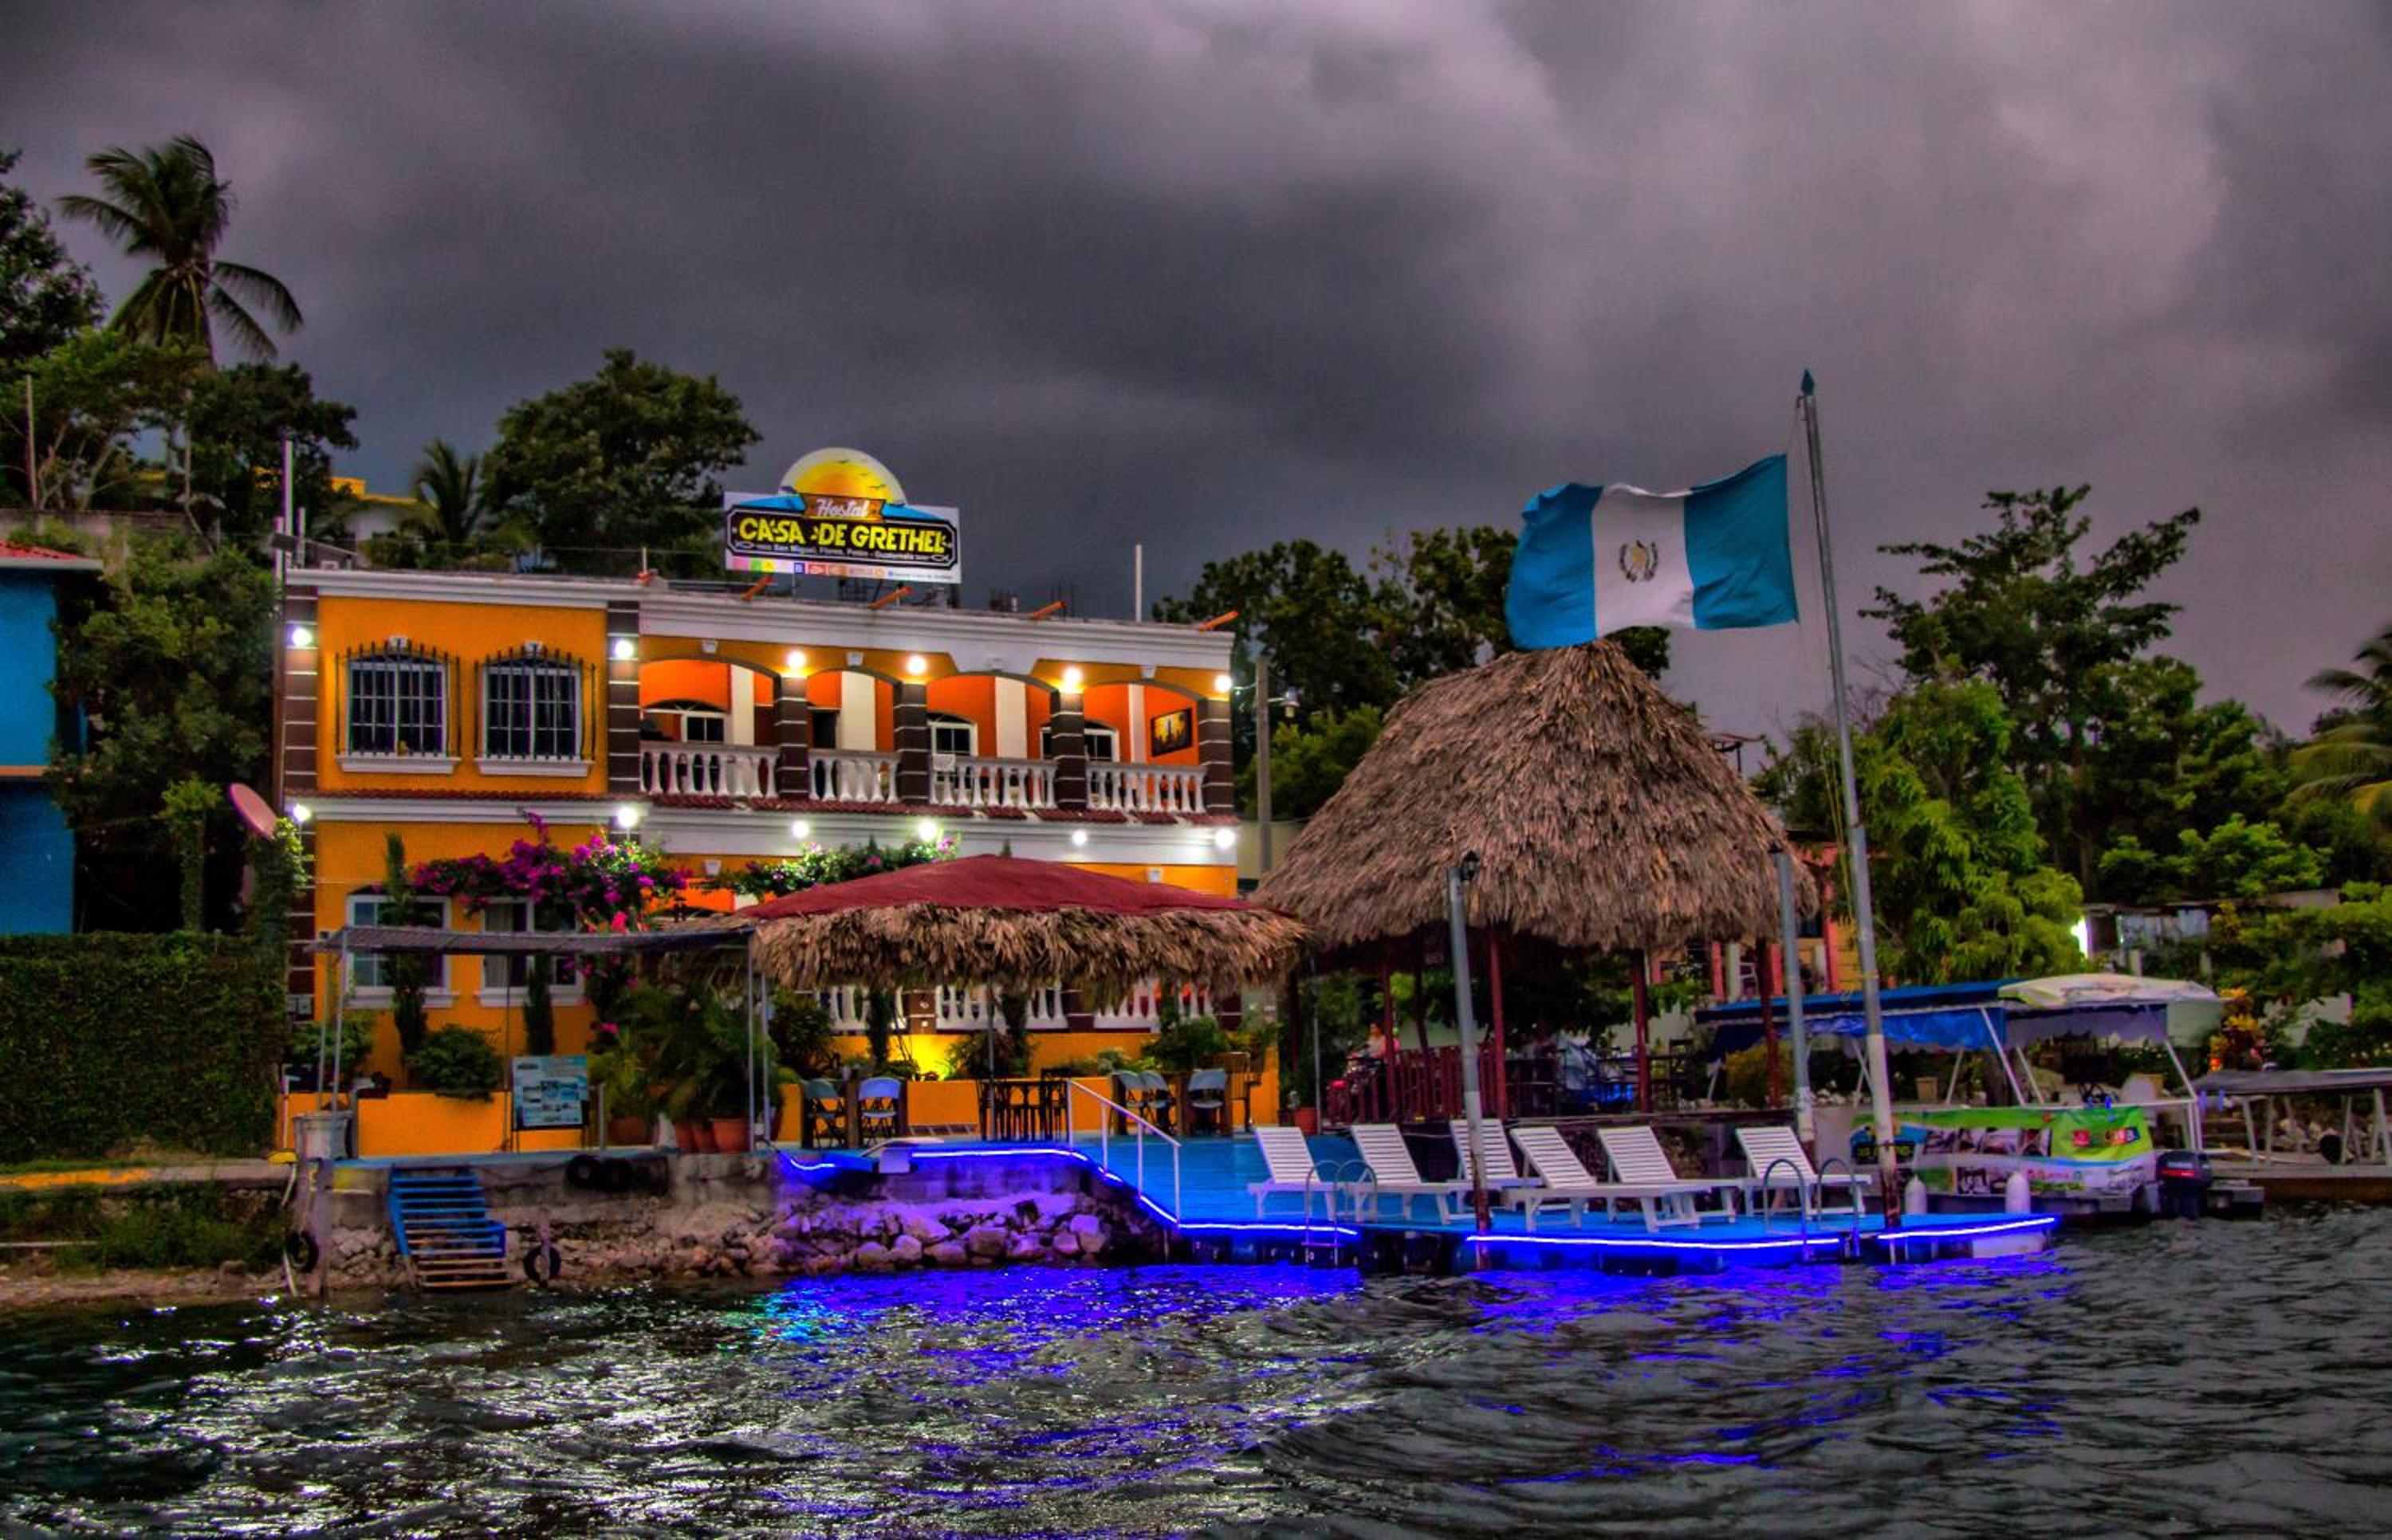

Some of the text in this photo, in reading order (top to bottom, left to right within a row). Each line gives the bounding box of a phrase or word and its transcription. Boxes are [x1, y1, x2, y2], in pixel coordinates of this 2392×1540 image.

[816, 498, 870, 517] Hostal
[739, 518, 946, 554] CASA DE GRETHEL
